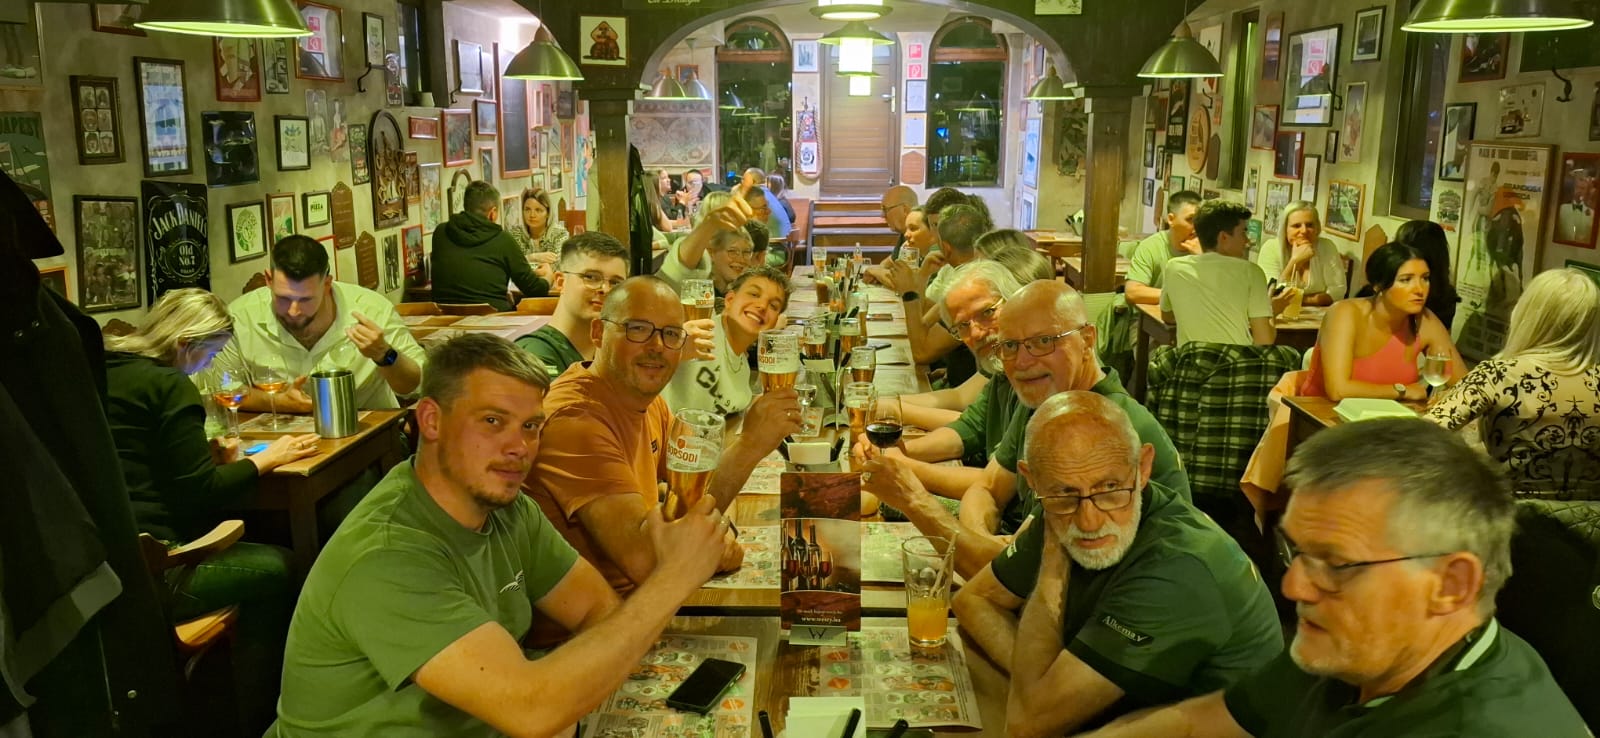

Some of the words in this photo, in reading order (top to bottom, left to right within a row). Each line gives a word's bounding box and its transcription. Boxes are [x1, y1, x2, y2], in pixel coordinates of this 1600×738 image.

[0, 117, 41, 138] APEST
[152, 209, 178, 240] JACK
[179, 245, 193, 256] Old
[1102, 615, 1136, 641] Alkema
